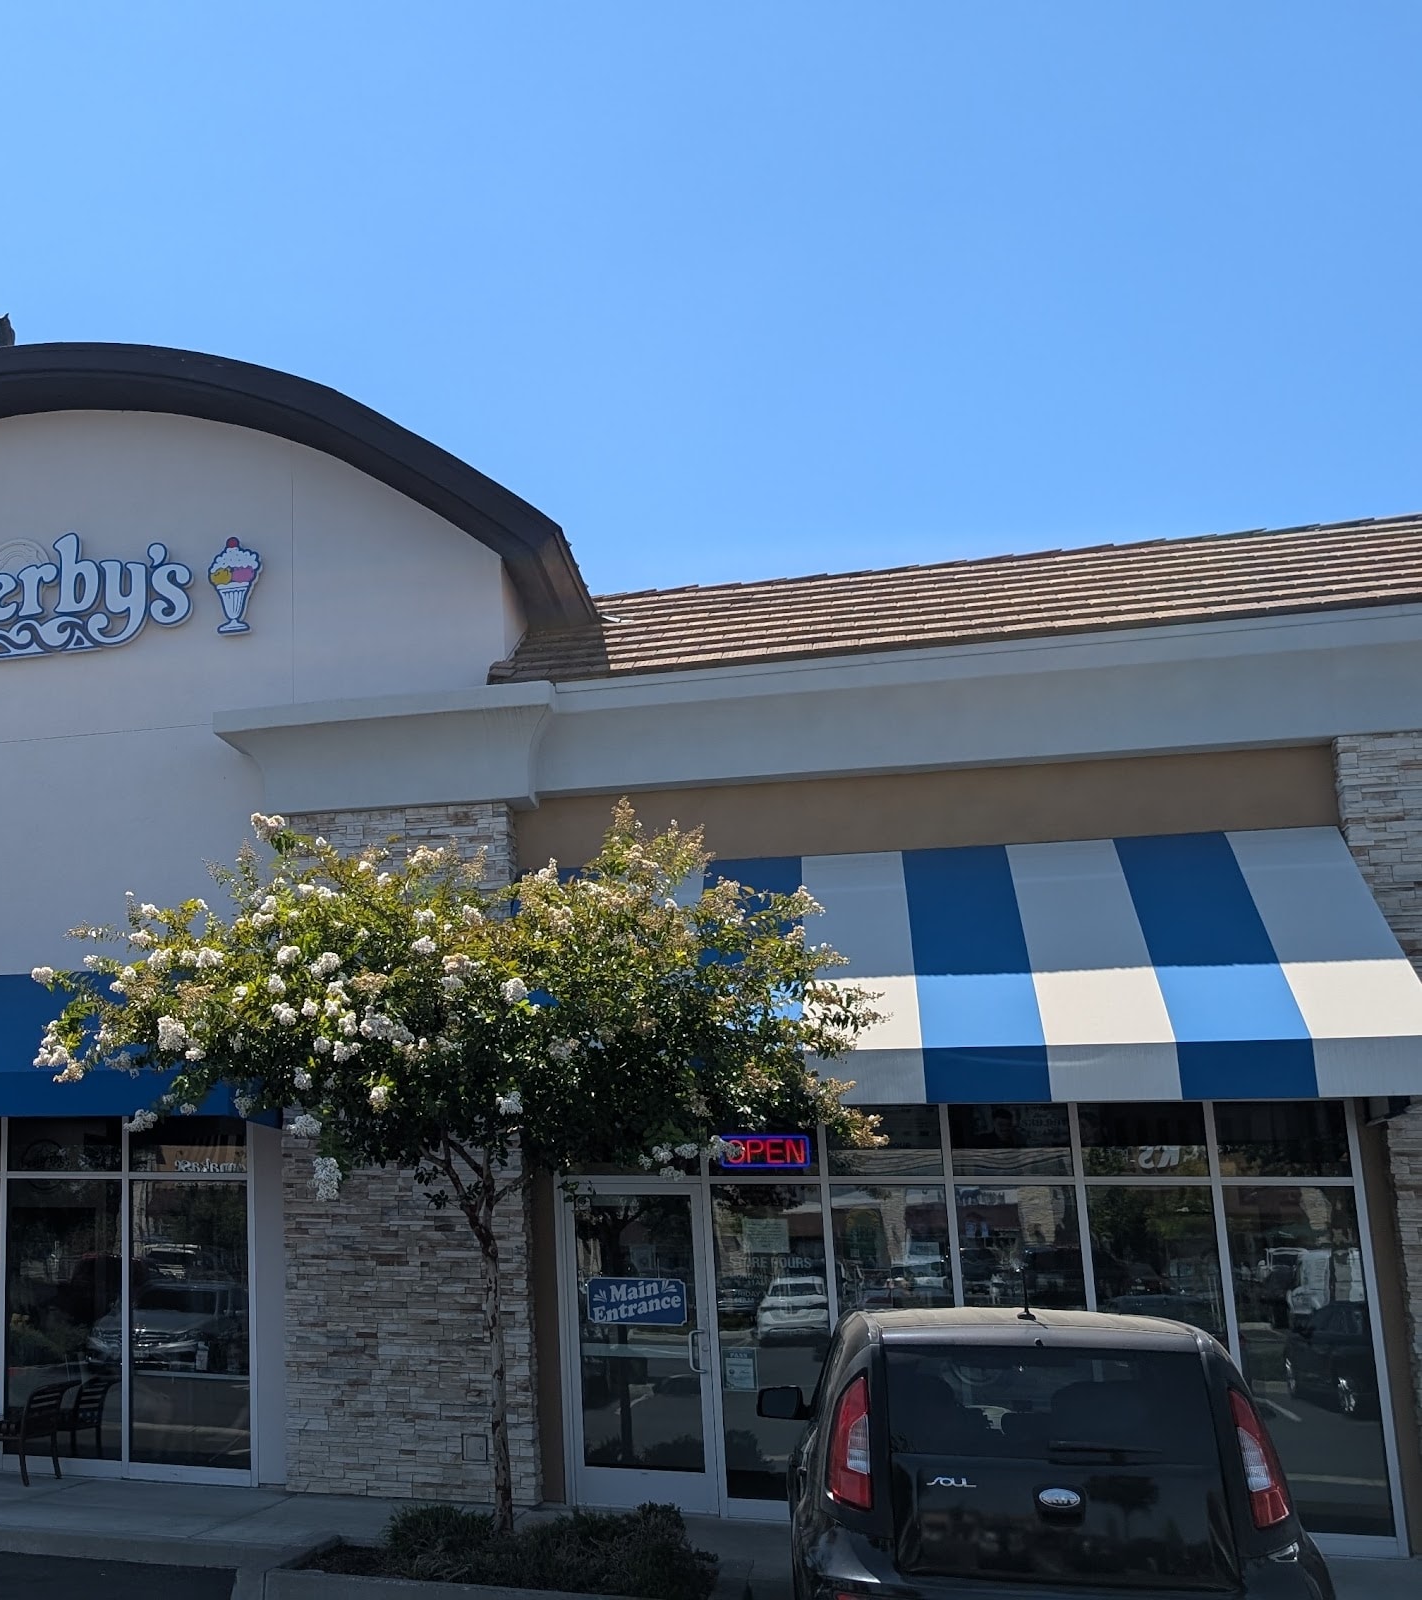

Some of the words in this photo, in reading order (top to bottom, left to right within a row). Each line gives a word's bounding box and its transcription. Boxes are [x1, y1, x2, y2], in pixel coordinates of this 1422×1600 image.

[727, 1138, 806, 1164] OPEN
[609, 1281, 659, 1303] Main
[592, 1295, 682, 1323] Entrance
[926, 1476, 977, 1488] SOUL
